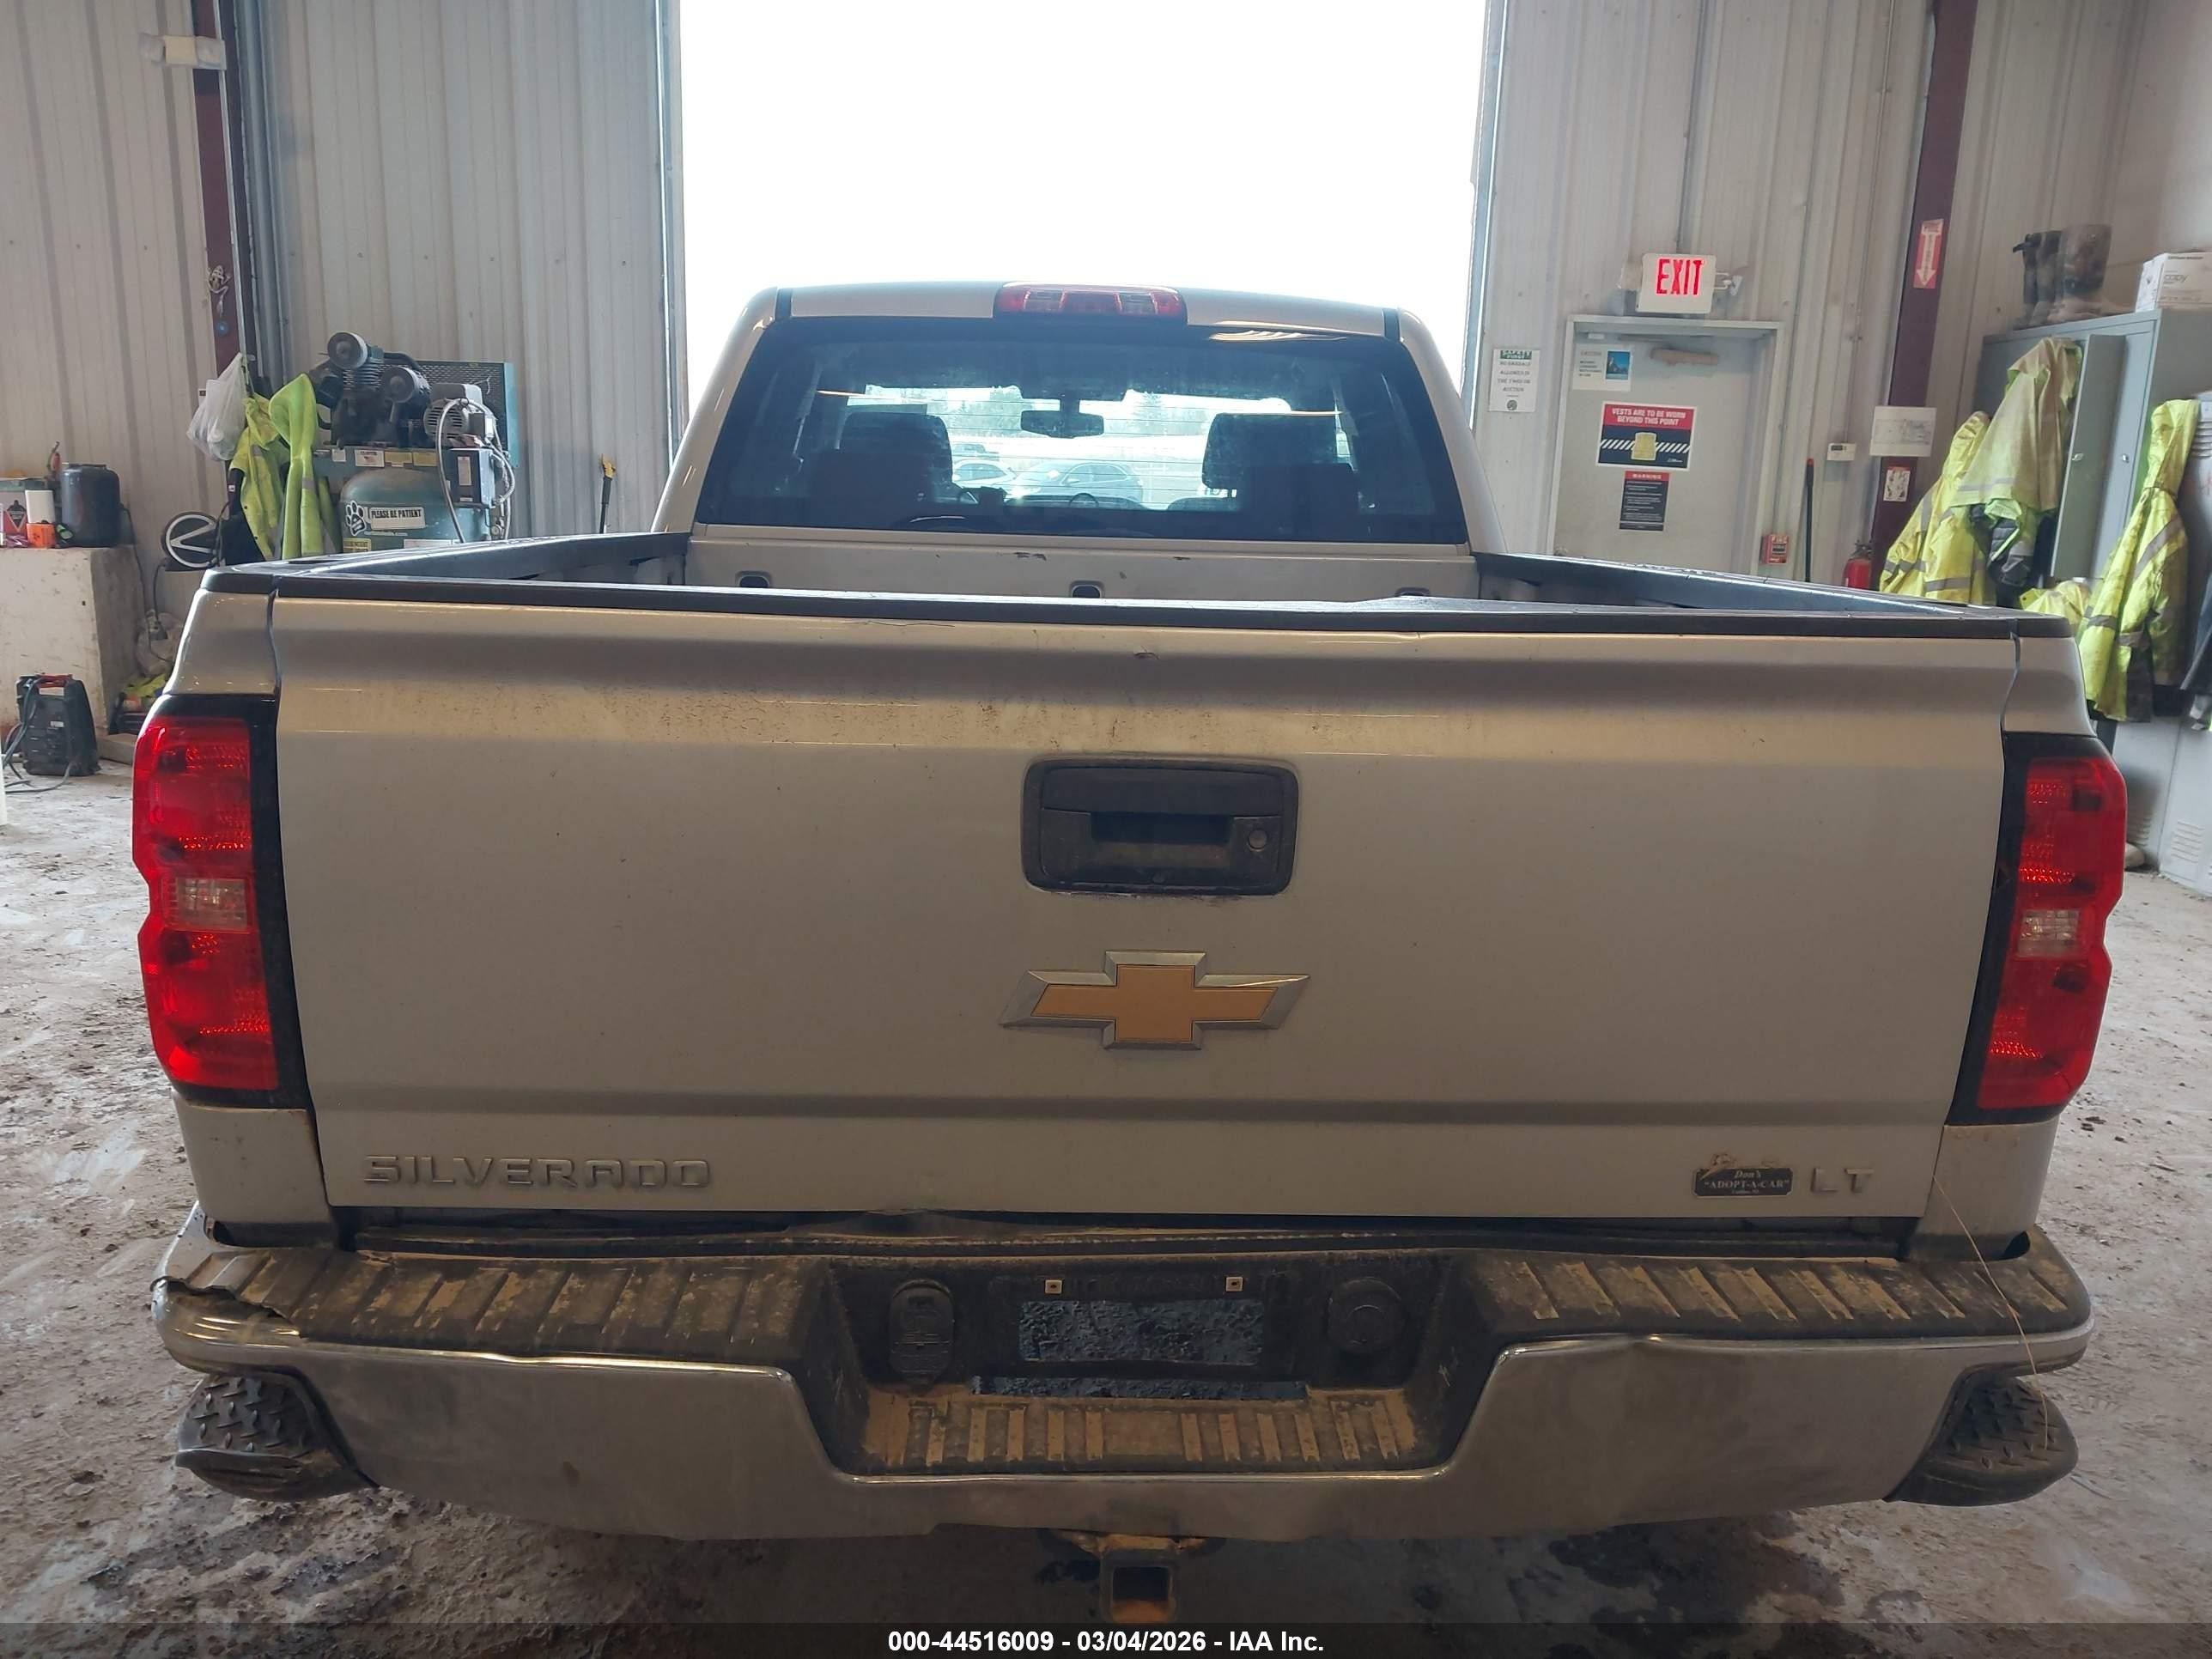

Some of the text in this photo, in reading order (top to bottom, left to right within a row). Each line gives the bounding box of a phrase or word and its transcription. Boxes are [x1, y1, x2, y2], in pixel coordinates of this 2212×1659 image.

[1656, 258, 1704, 295] EXIT
[371, 509, 422, 519] PLEASE BE PATIENT
[364, 1155, 711, 1188] SILVERADO
[1810, 1167, 1875, 1194] LT
